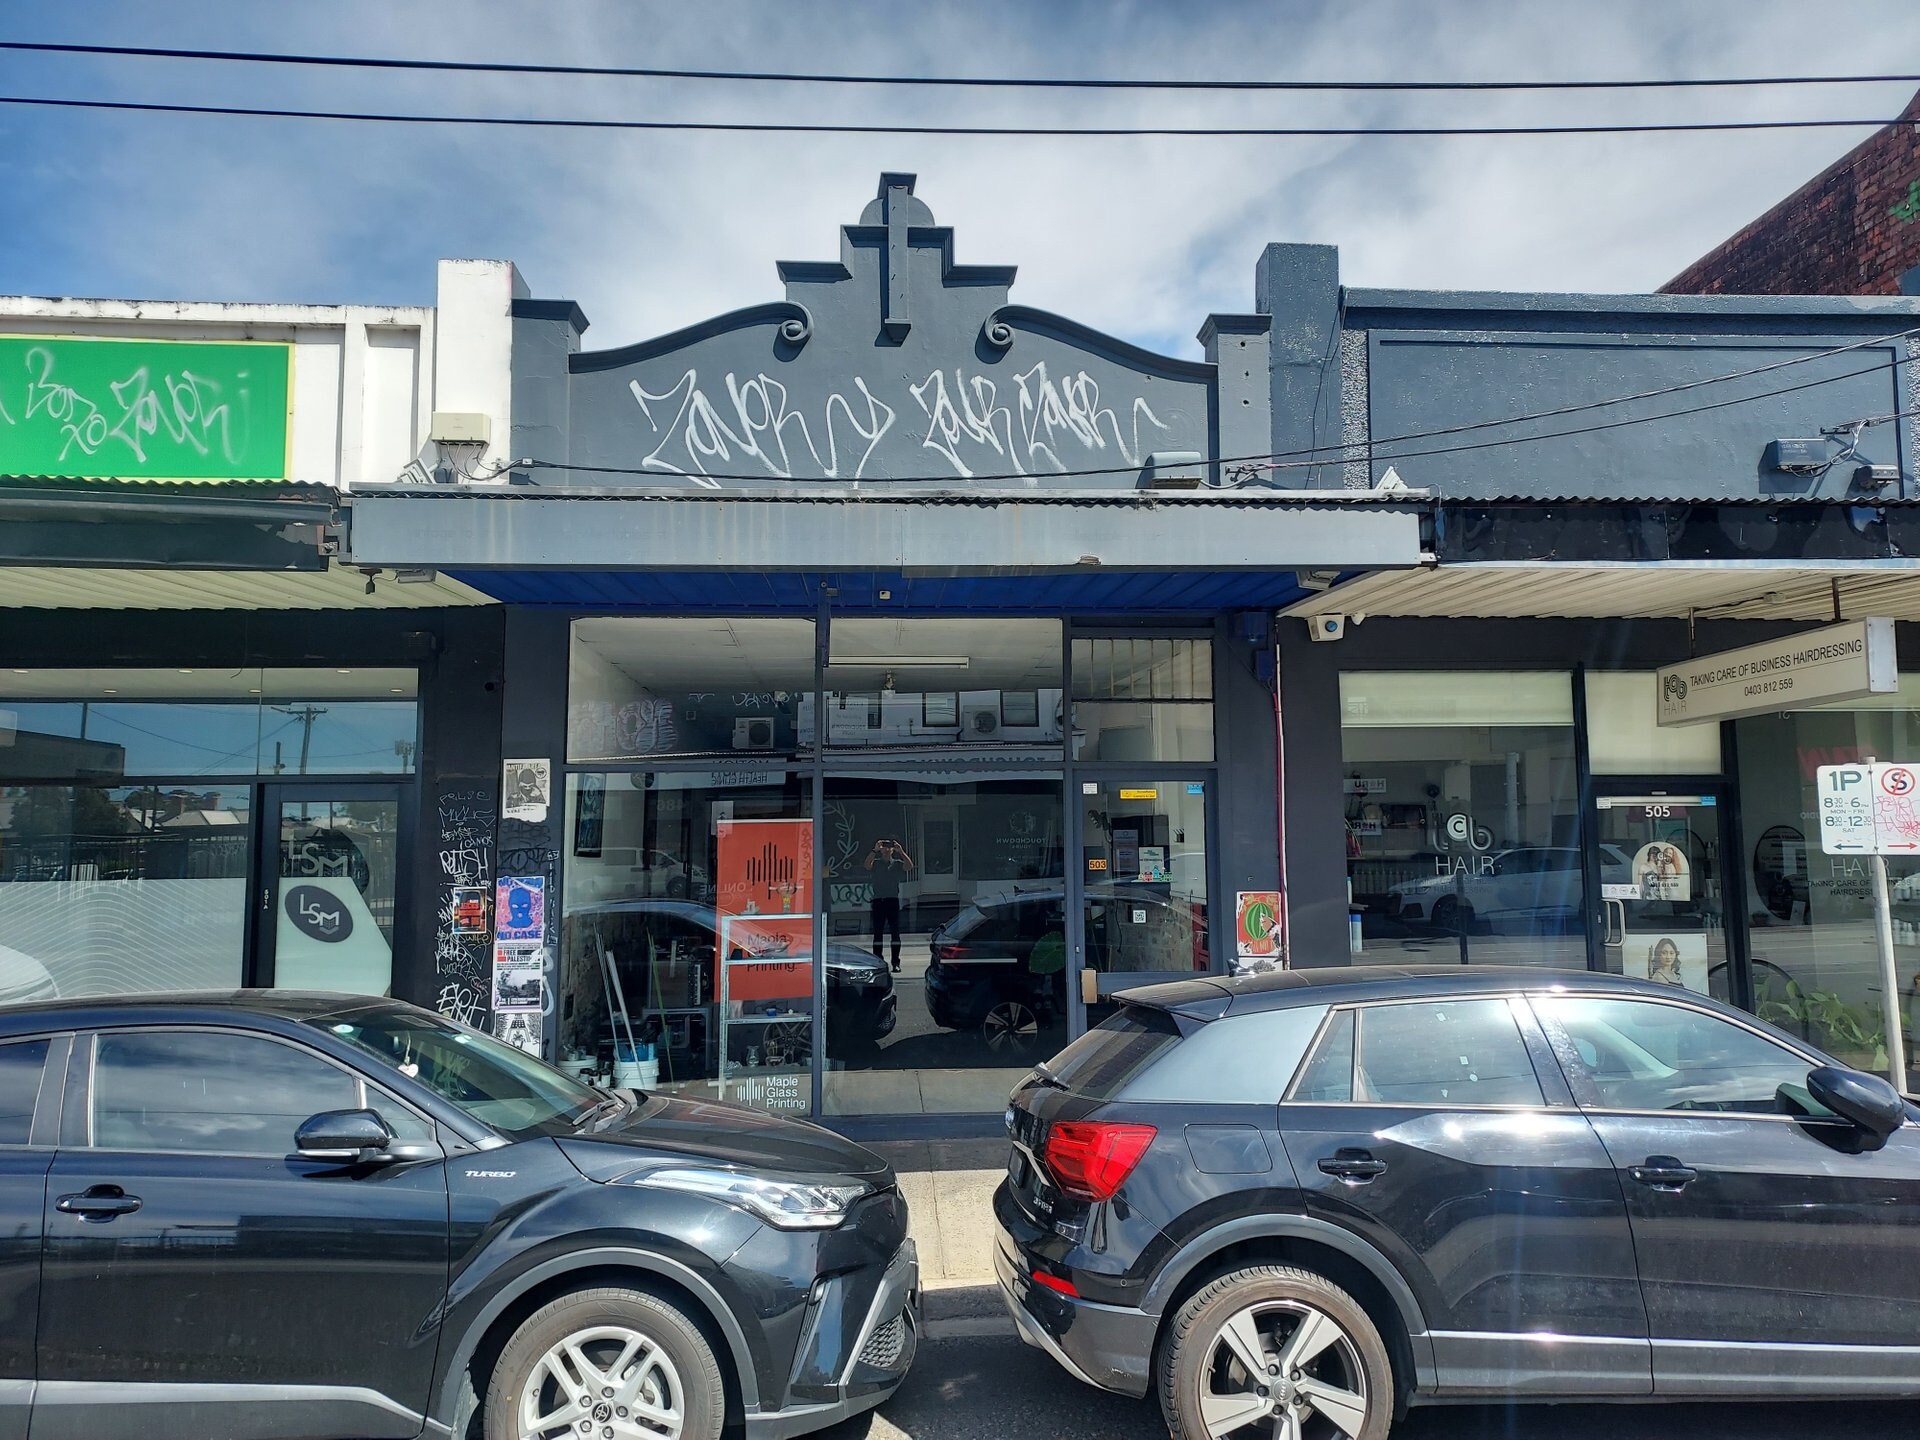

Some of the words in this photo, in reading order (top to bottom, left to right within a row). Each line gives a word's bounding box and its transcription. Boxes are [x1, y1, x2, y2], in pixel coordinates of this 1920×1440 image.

[1690, 673, 1715, 687] TAKING
[1716, 667, 1737, 682] CARE
[1738, 664, 1750, 676] OF
[1751, 654, 1792, 675] BUSINESS
[1793, 639, 1863, 665] HAIRDRESSING
[1744, 684, 1762, 697] 0403
[1763, 681, 1778, 694] 812
[1778, 678, 1793, 691] 559
[1663, 699, 1687, 716] HAIR
[1828, 771, 1862, 792] 1P
[1645, 806, 1671, 817] 505
[1089, 860, 1107, 869] 503
[1434, 856, 1495, 875] HAIR
[299, 893, 340, 927] LSM
[513, 930, 542, 940] CASE
[766, 1076, 799, 1088] Maple
[766, 1087, 798, 1098] Glass
[766, 1098, 806, 1109] Printing
[464, 1170, 517, 1178] TURBO
